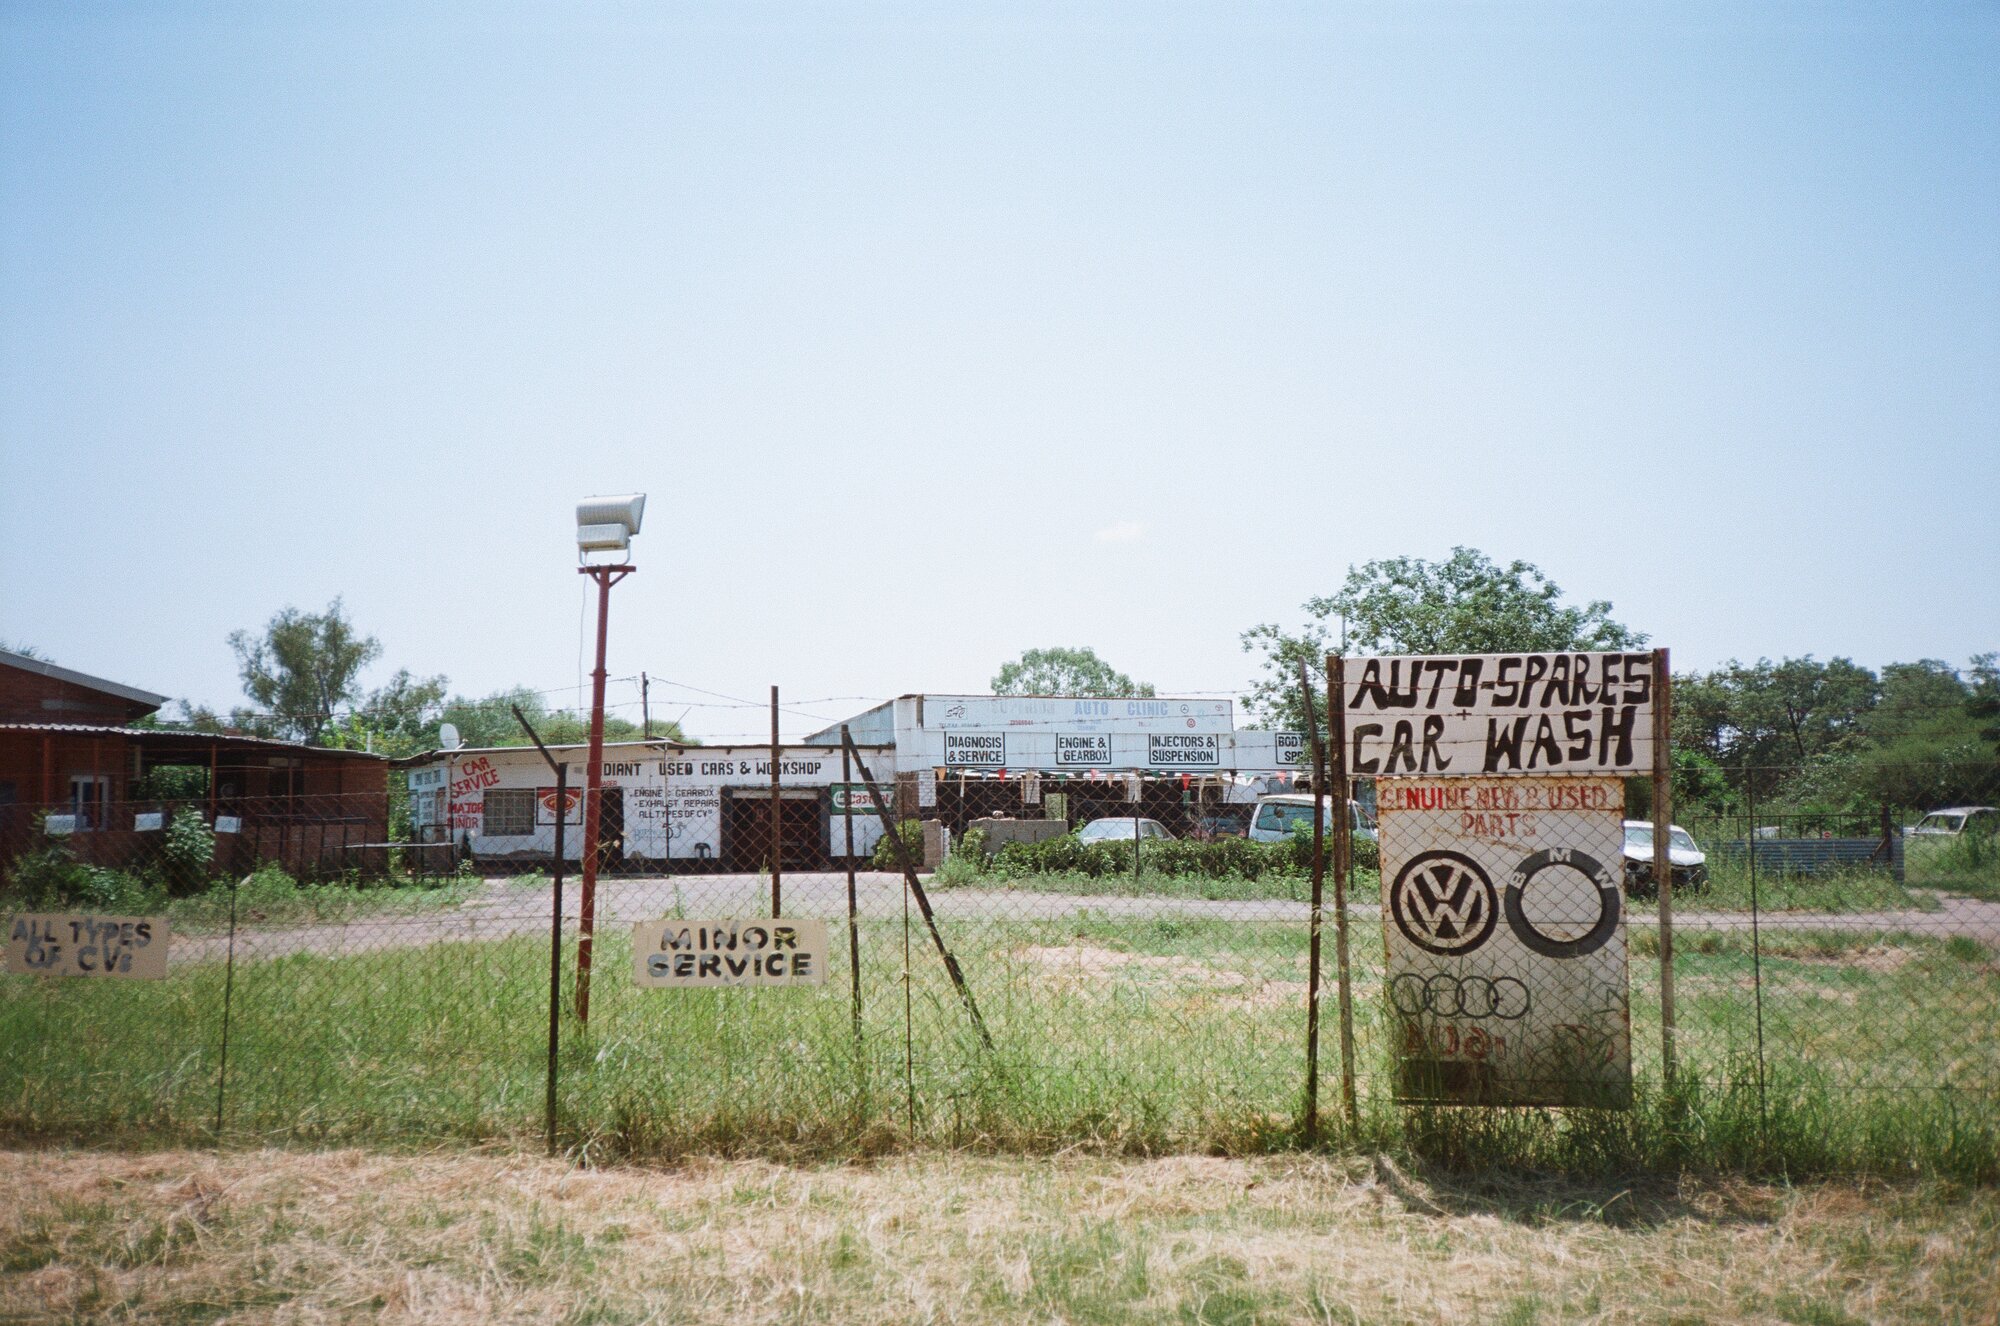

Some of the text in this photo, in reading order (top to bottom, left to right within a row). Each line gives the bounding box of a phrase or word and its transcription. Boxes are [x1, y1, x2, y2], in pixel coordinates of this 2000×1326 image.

[1348, 653, 1652, 710] AUTO-SPARES
[1073, 701, 1110, 716] AUTO
[1126, 701, 1169, 716] CLINIC
[947, 735, 1002, 749] DIAGNOSIS
[1058, 736, 1107, 749] ENGINE &
[1151, 735, 1216, 748] INJECTORS &
[1277, 736, 1304, 748] BODY
[1352, 706, 1638, 774] CAR WASH
[947, 750, 1003, 763] & SERVICE
[1063, 749, 1109, 762] GEARBOX
[1152, 750, 1214, 763] SUSPENSION
[462, 756, 491, 776] CAR
[658, 762, 693, 776] USED
[701, 762, 734, 776] CARS
[739, 761, 751, 775] &
[451, 769, 500, 799] SERVICE
[634, 788, 664, 798] ENGINE
[675, 788, 714, 798] GEARBOX
[1381, 785, 1470, 810] GENUINE
[1549, 785, 1608, 810] USED
[638, 799, 720, 808] EXHAUST REPAIRS
[638, 810, 654, 819] ALL
[684, 809, 695, 818] OF
[1459, 812, 1537, 838] PARTS
[12, 918, 152, 947] ALL TYPES
[660, 923, 798, 951] MINOR
[25, 944, 61, 969] OF
[647, 952, 813, 979] SERVICE
